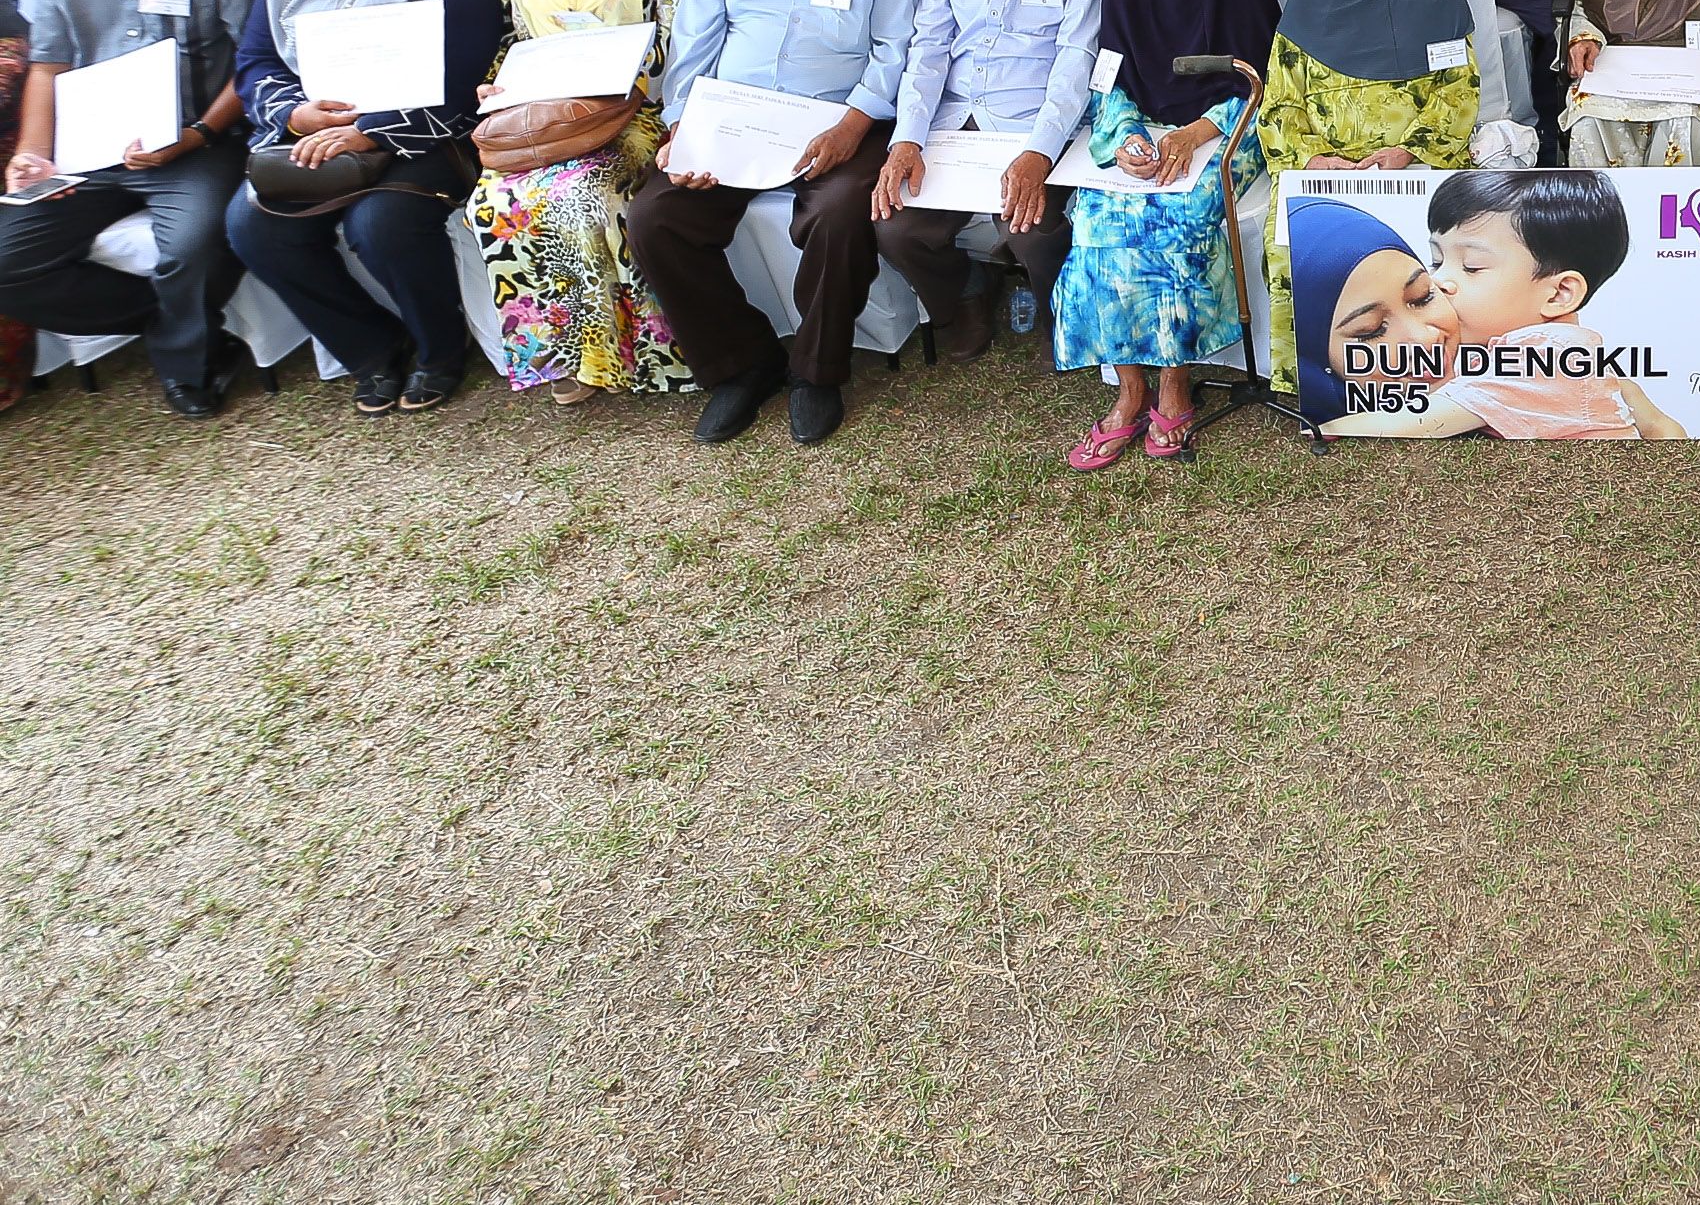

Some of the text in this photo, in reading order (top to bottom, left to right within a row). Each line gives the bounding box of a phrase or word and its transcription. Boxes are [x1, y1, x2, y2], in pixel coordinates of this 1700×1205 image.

[1657, 250, 1696, 258] KASIH
[1344, 343, 1668, 379] DUN DENGKIL
[1345, 380, 1430, 414] N55
